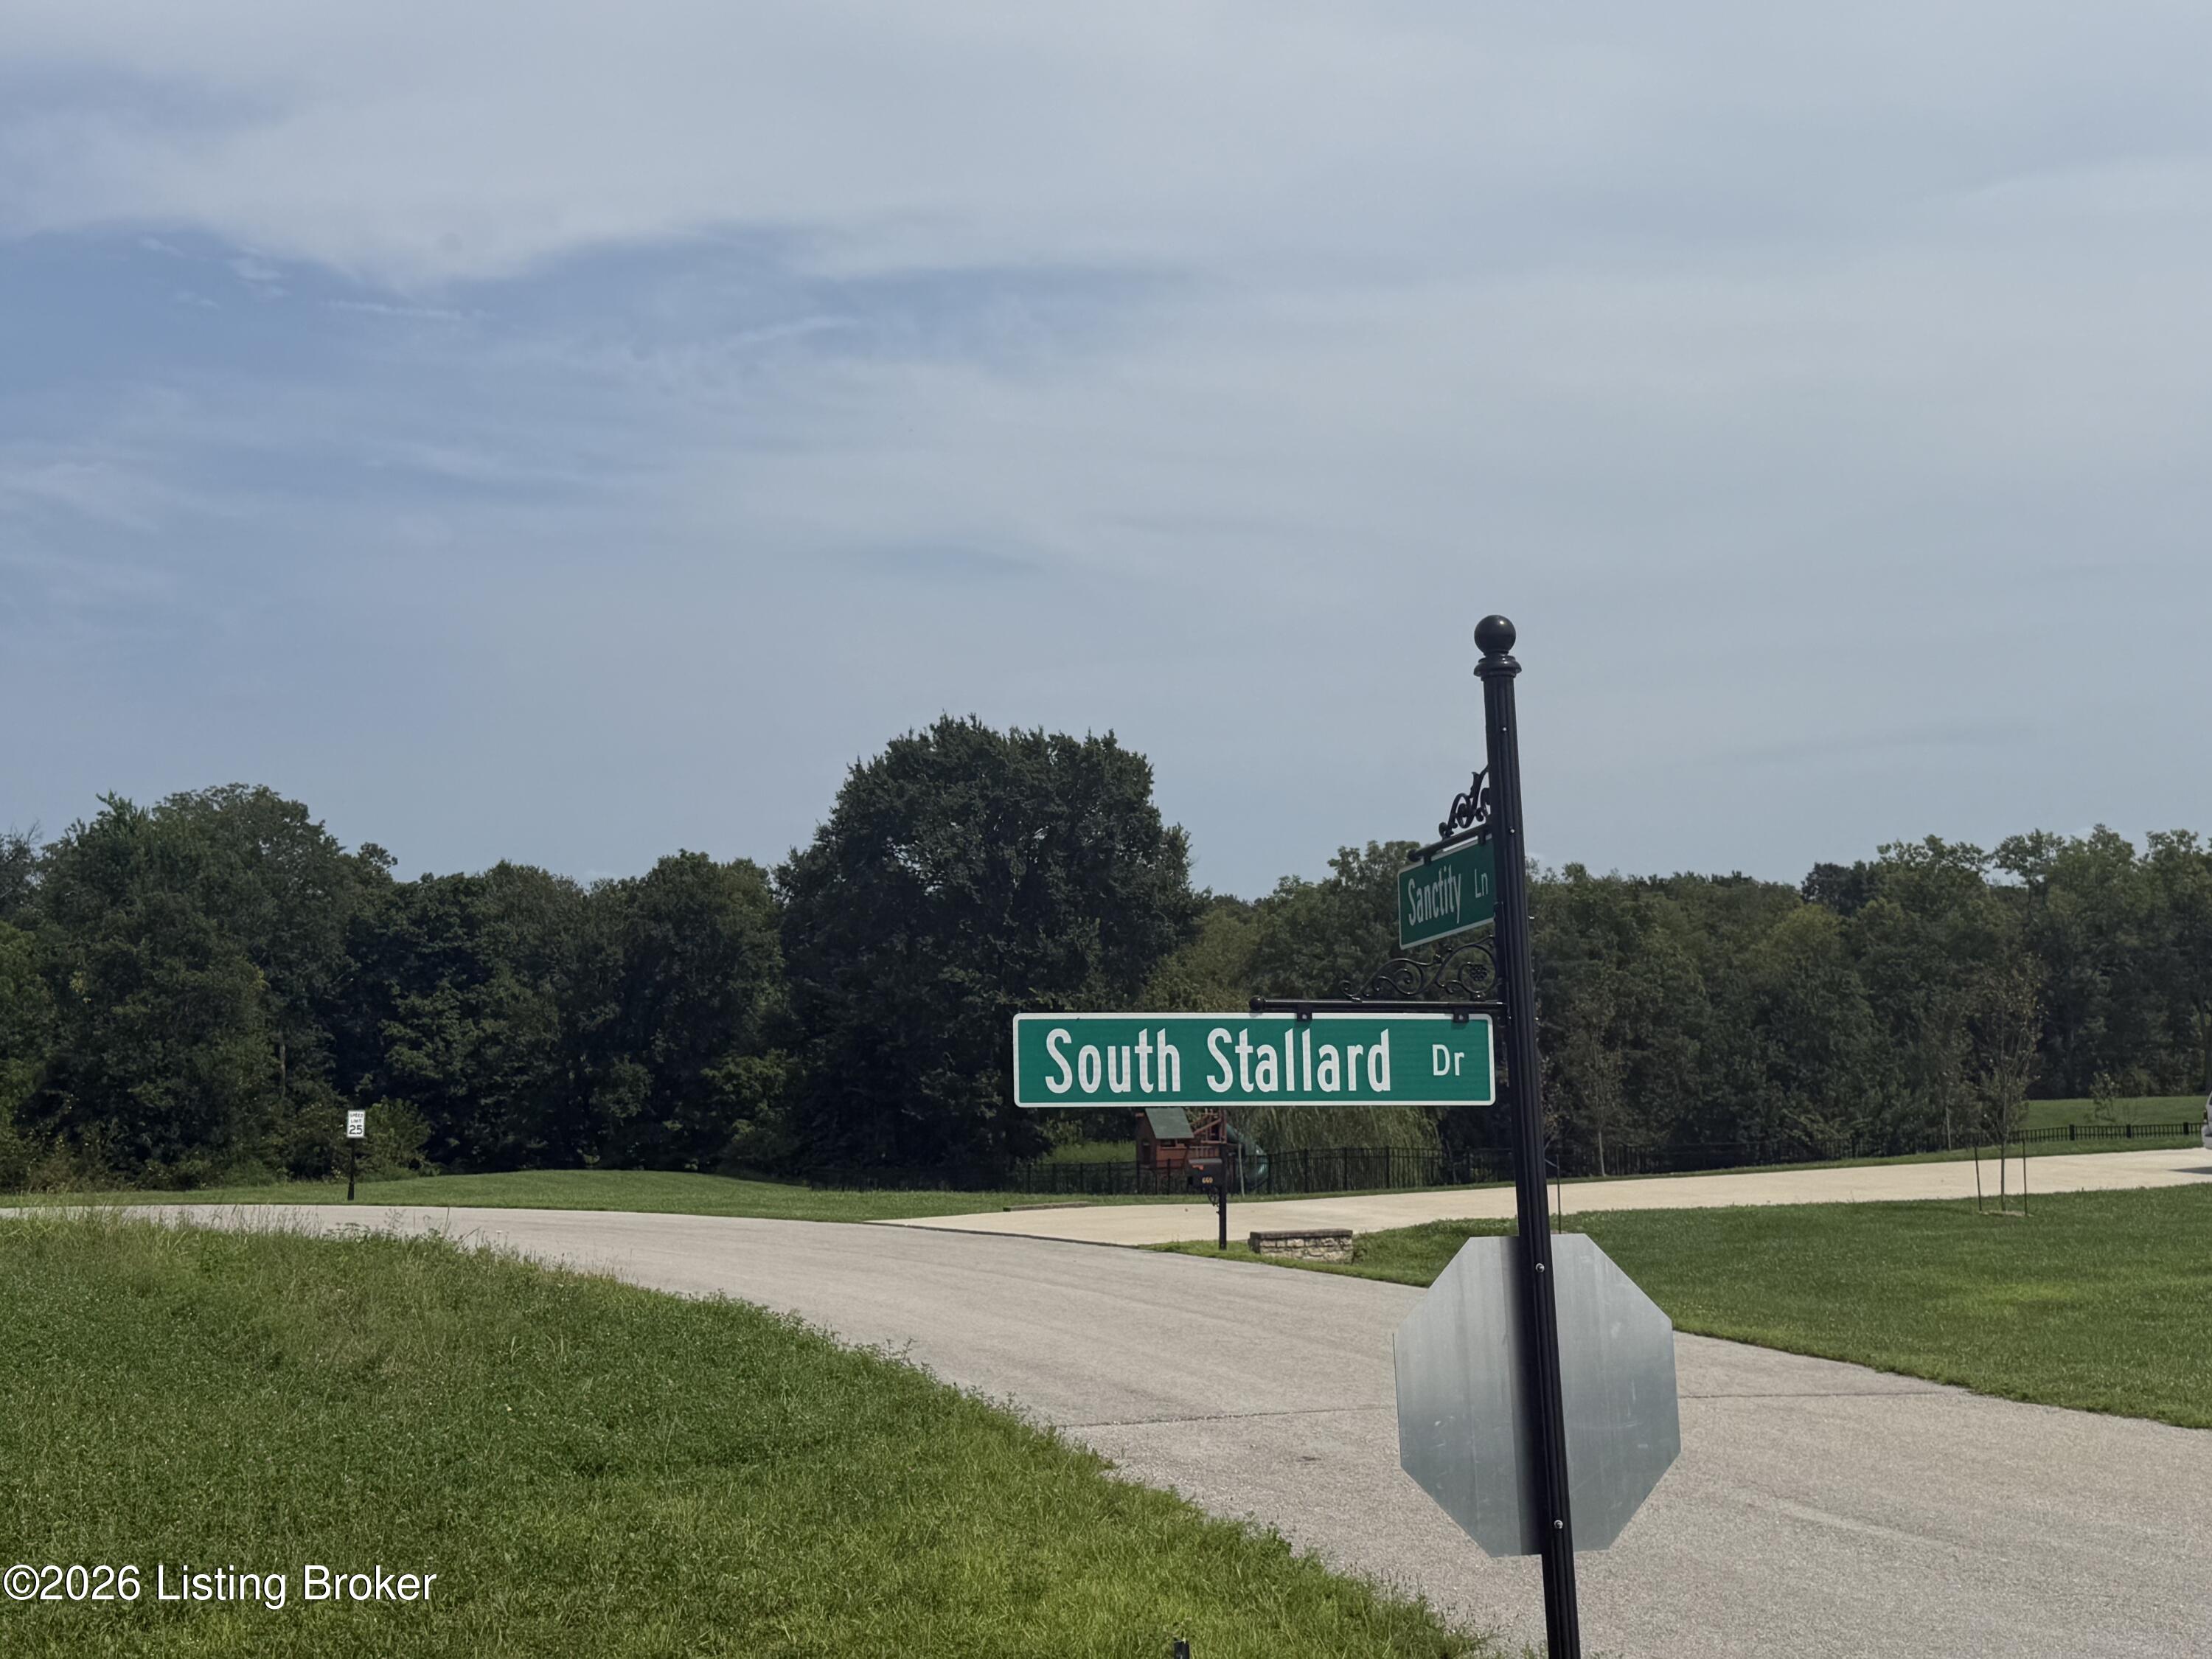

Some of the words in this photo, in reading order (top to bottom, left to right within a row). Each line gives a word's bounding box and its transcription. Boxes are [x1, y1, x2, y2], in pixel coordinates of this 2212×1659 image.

[1408, 864, 1461, 926] Sanctity
[1475, 869, 1489, 899] Ln
[1045, 1028, 1180, 1093] South
[1206, 1027, 1391, 1093] Stallard
[1432, 1044, 1465, 1077] Dr
[349, 1124, 363, 1135] 25
